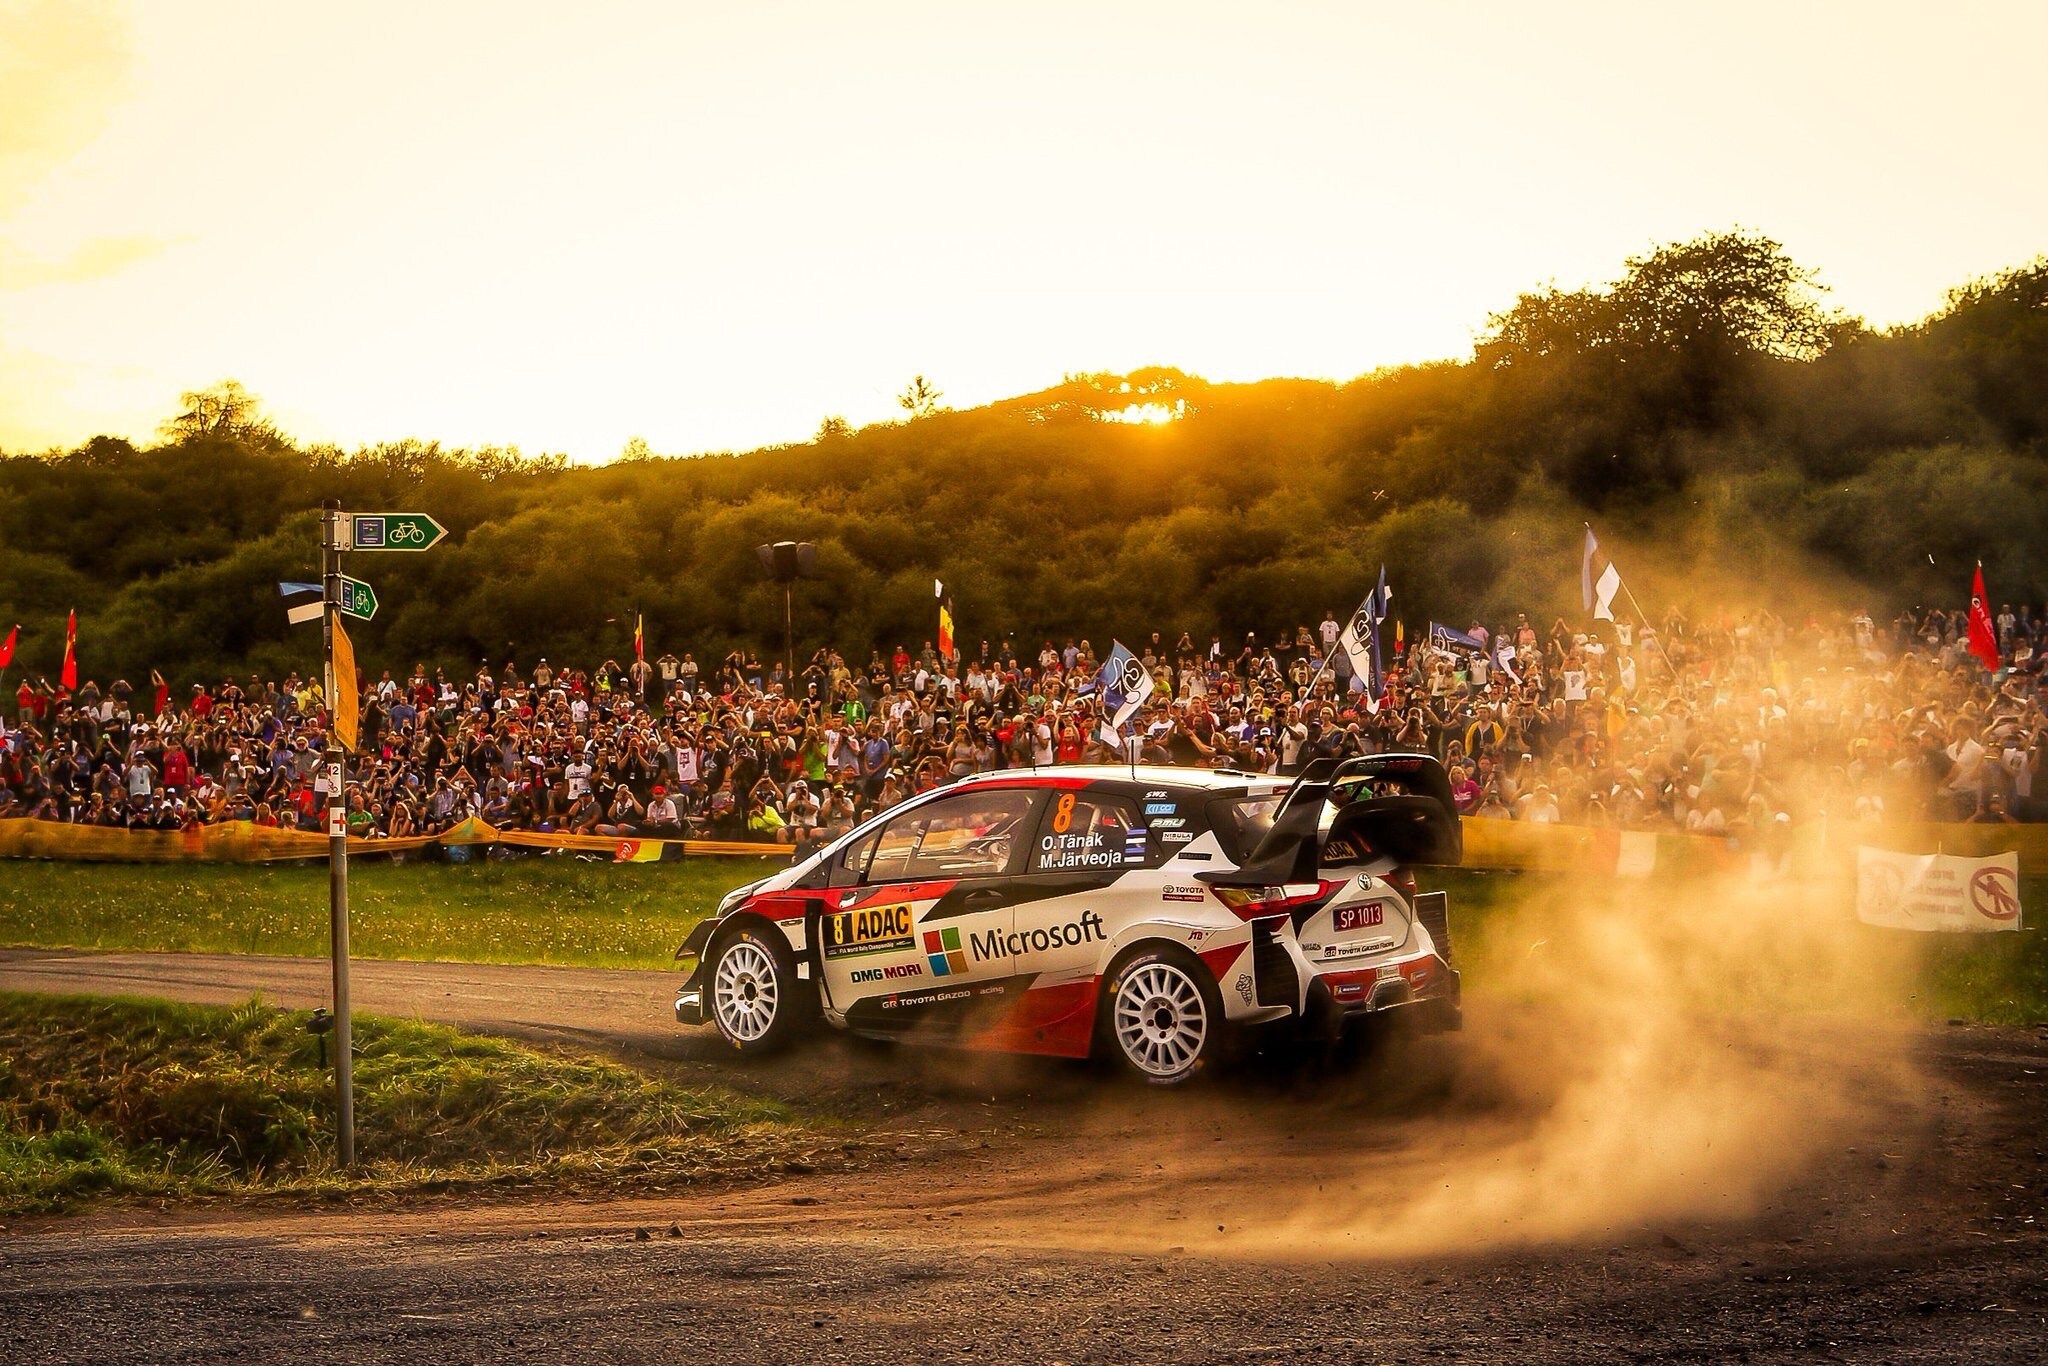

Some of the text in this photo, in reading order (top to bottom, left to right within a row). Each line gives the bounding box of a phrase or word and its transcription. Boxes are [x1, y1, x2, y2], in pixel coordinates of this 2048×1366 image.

[332, 765, 339, 775] 2
[1053, 793, 1076, 833] 8
[1041, 833, 1104, 850] O.Tänak
[1040, 849, 1122, 869] M.Järveoja
[857, 906, 909, 940] ADAC
[1340, 905, 1381, 929] SP 1013
[833, 914, 844, 945] 8
[969, 910, 1107, 961] Microsoft
[1338, 946, 1361, 956] TOYOTA
[850, 963, 923, 983] DMG MORI
[899, 995, 936, 1006] TOYOTA
